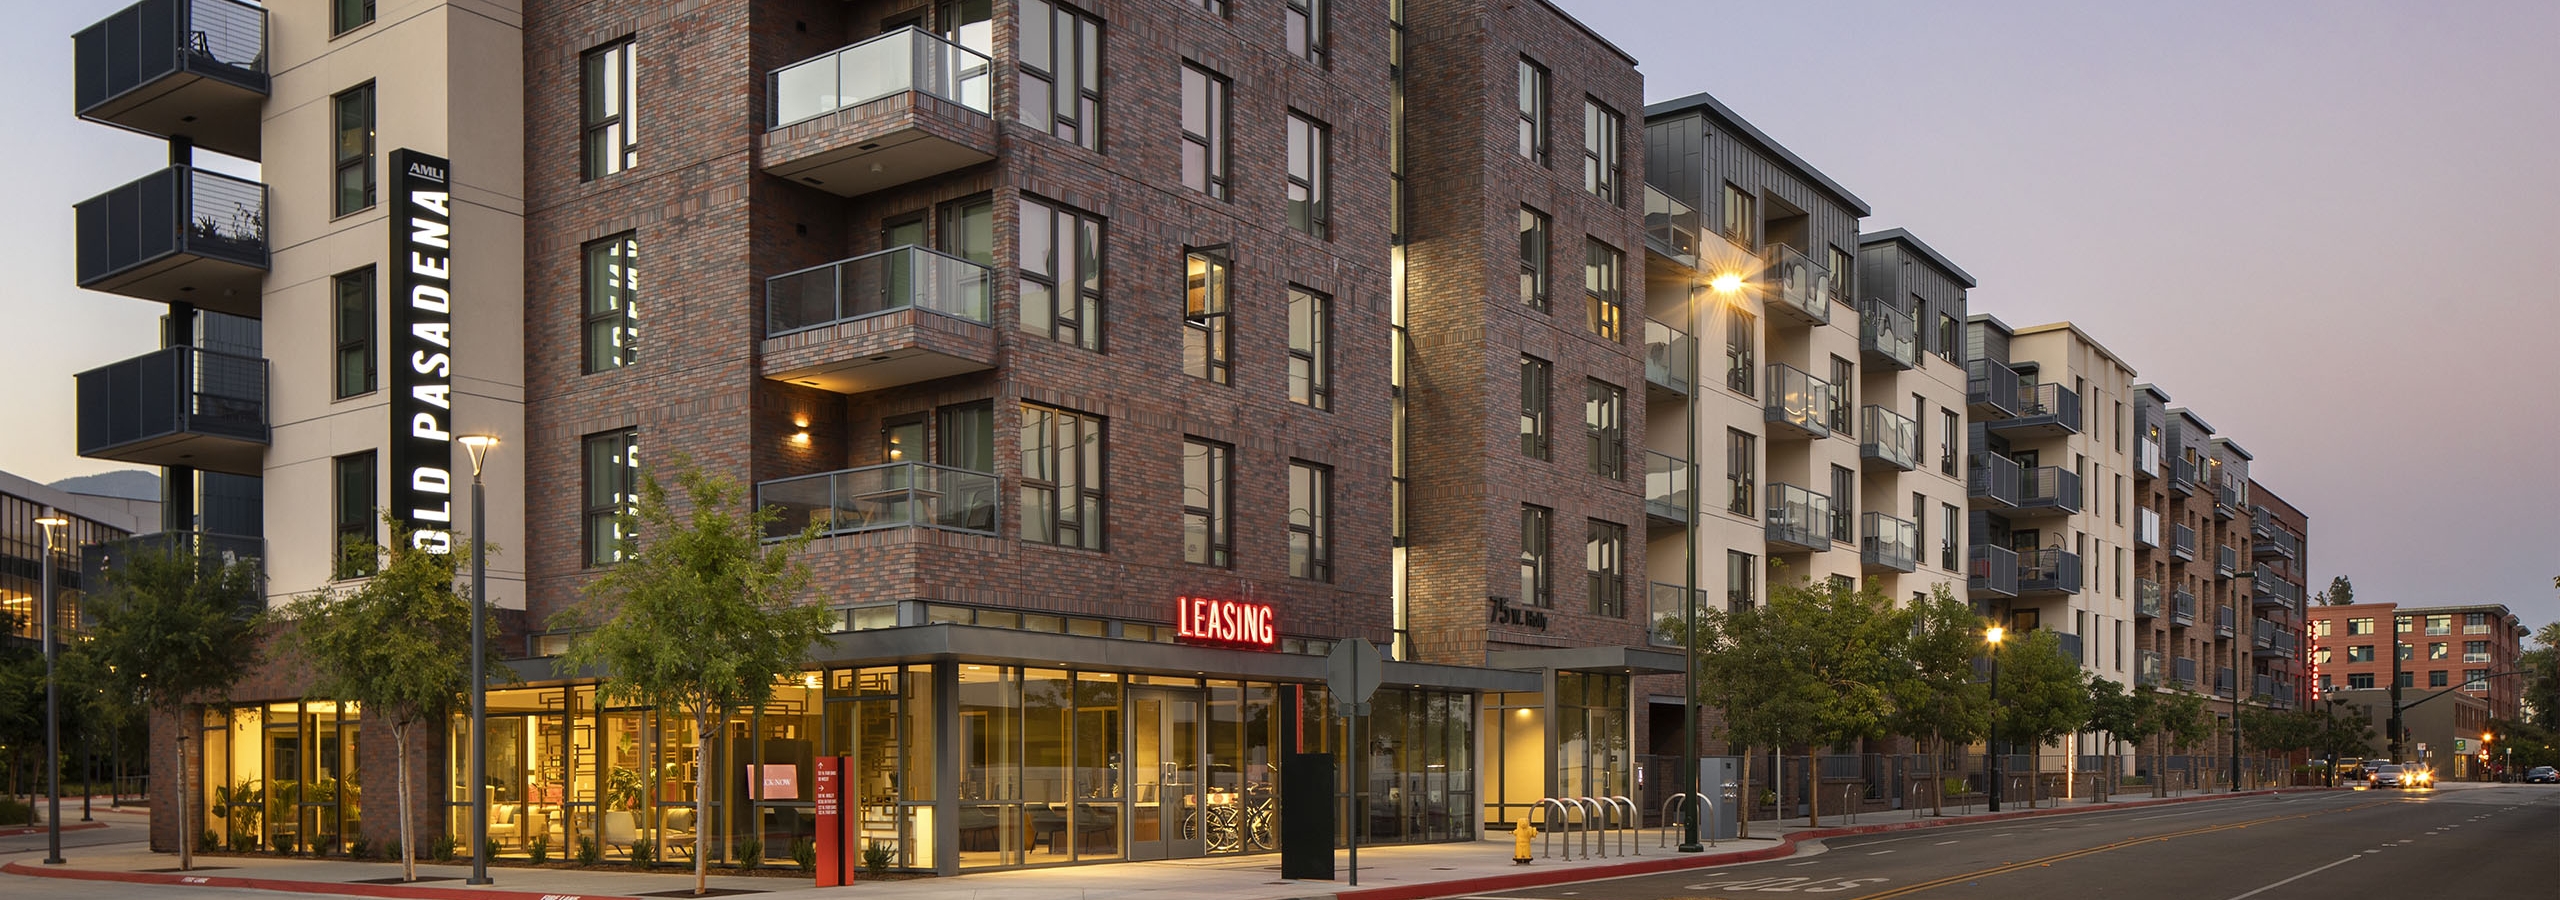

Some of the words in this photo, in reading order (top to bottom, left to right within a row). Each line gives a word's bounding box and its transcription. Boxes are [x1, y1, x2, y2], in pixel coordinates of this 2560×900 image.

[409, 162, 444, 180] AMLI
[412, 191, 449, 441] PASADENA
[412, 466, 450, 555] OLD
[1177, 597, 1273, 644] LEASING
[1489, 596, 1510, 624] 75
[1525, 610, 1548, 632] Holly
[1684, 877, 1891, 893] STOP
